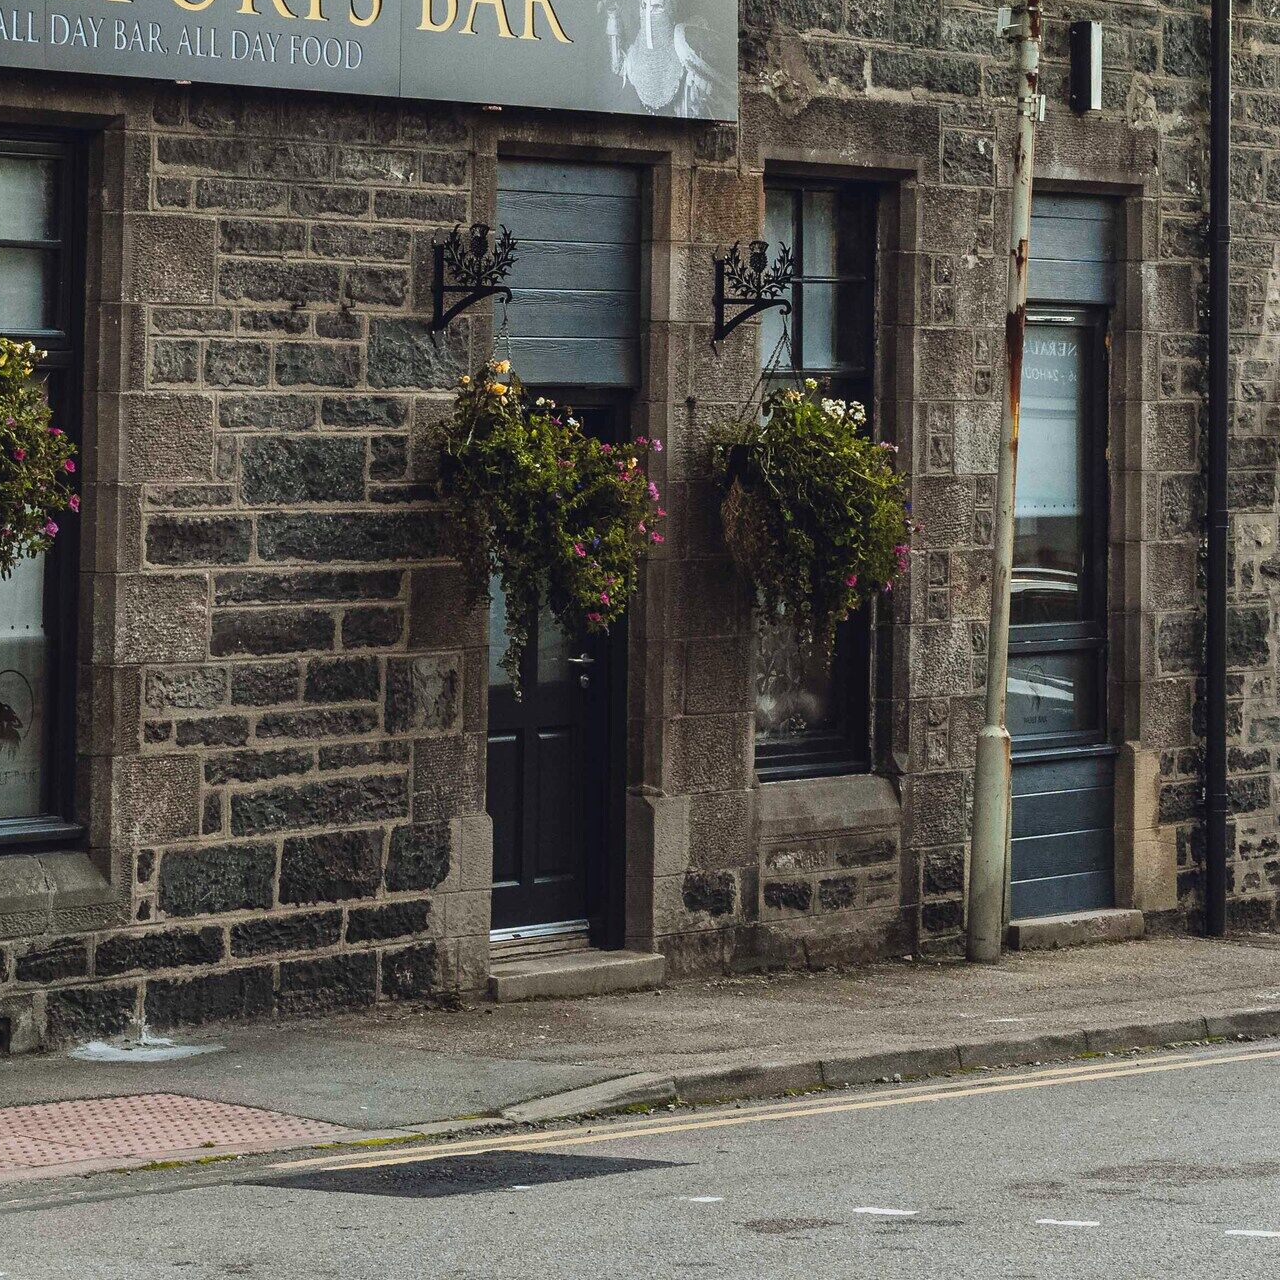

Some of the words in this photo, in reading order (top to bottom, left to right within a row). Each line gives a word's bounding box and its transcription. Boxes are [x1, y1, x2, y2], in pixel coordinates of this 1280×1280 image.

[50, 13, 106, 48] DAY
[114, 19, 169, 56] BAR,
[176, 25, 222, 58] ALL
[231, 29, 282, 63] DAY
[290, 34, 364, 70] FOOD
